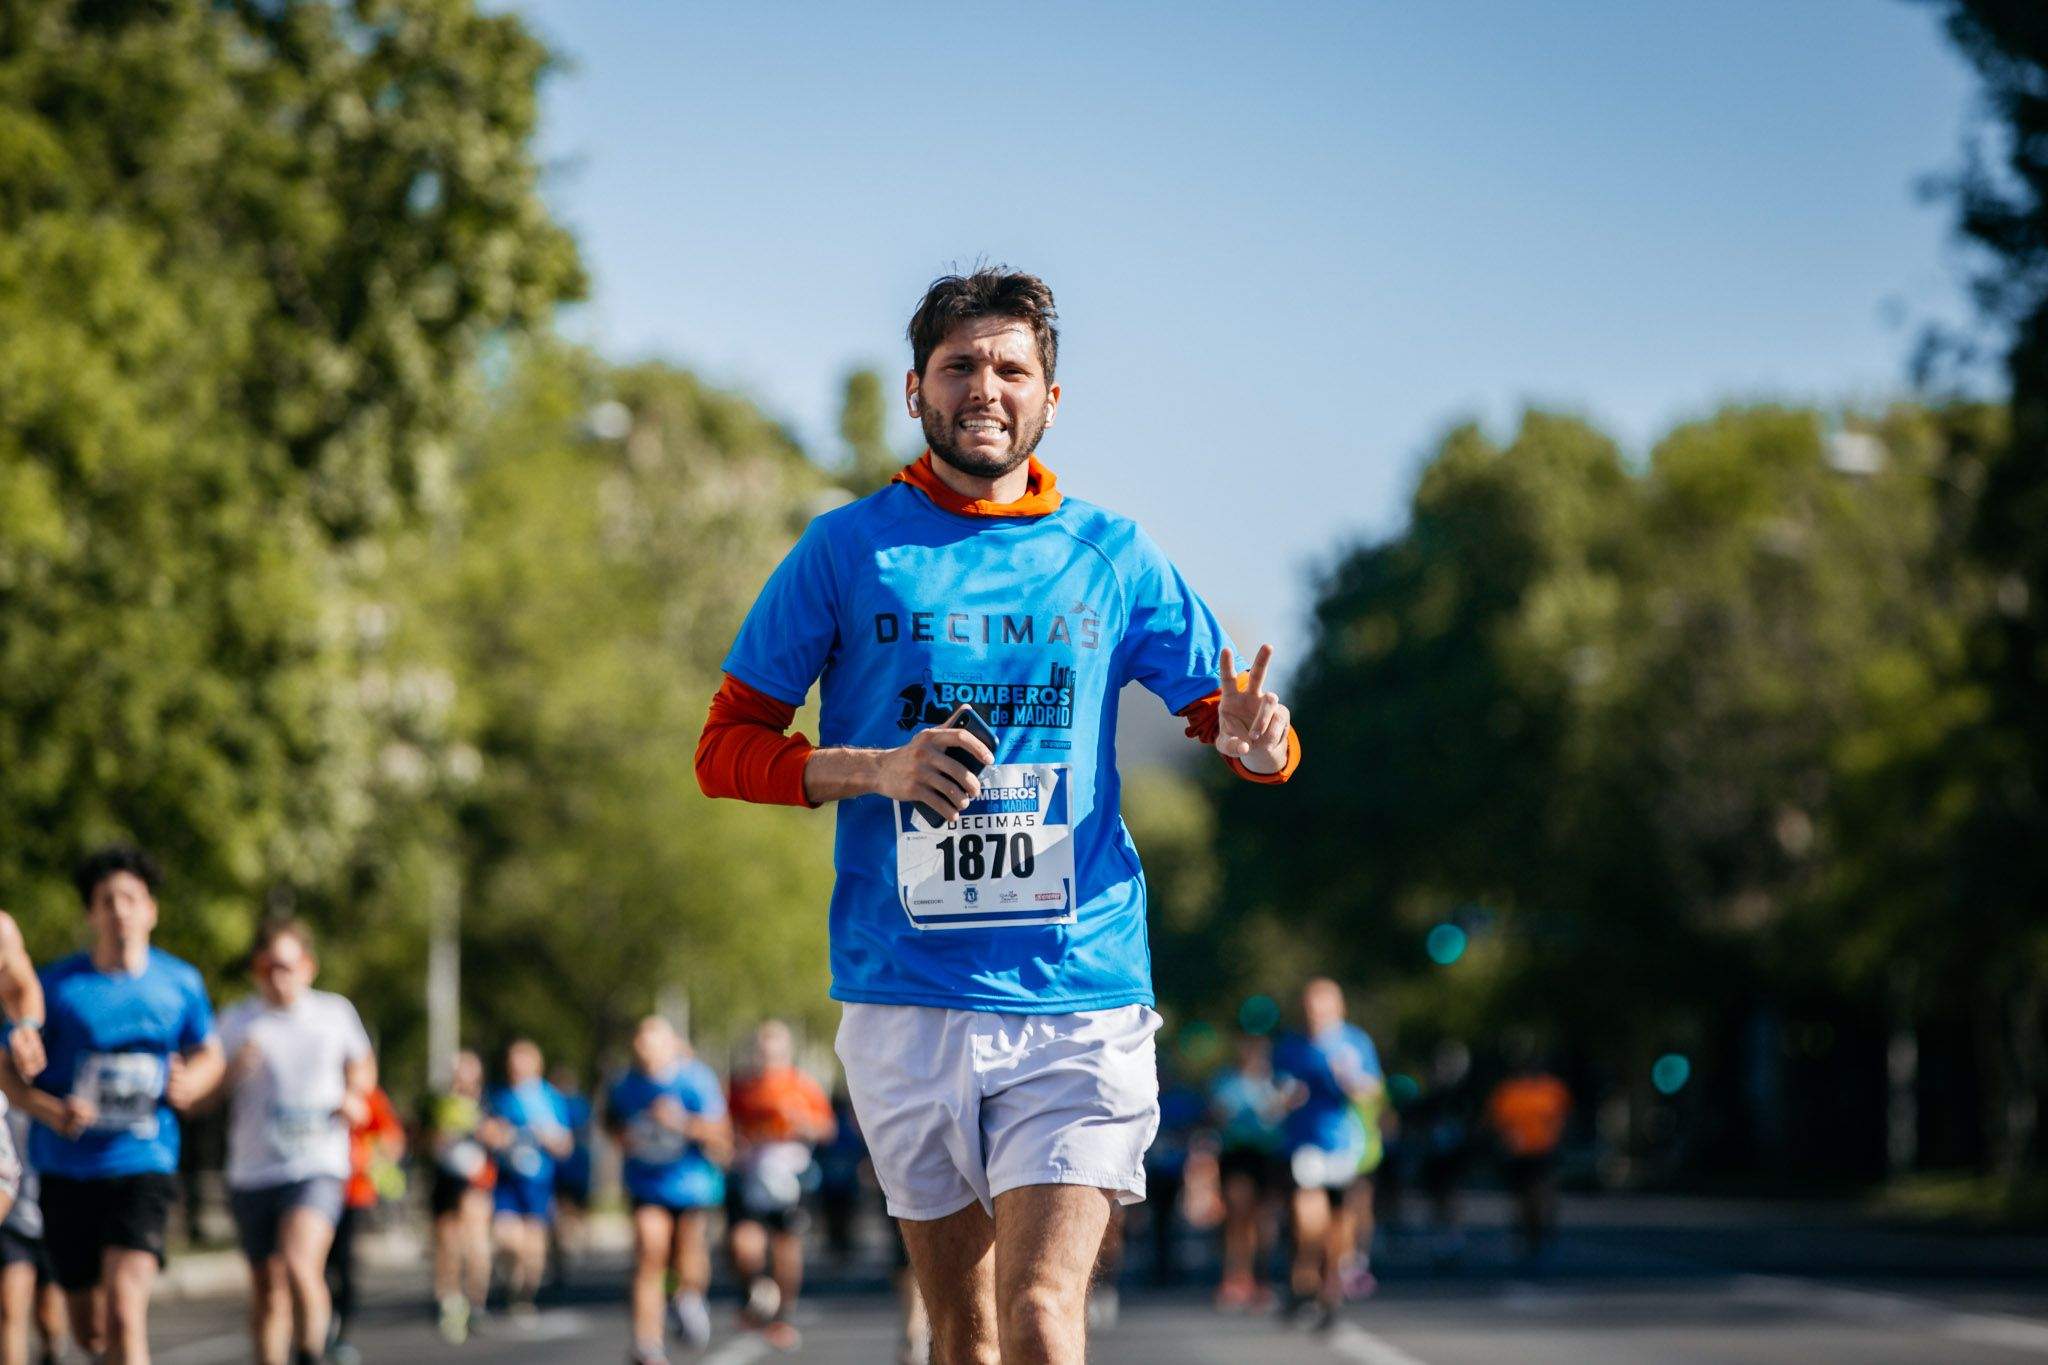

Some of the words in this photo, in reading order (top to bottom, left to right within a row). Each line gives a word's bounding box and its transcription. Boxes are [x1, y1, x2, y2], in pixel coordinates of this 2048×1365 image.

[874, 612, 1100, 649] DECIMAS
[941, 684, 1070, 705] BOMBEROS
[990, 705, 1009, 725] de
[1013, 705, 1070, 727] MADRID
[968, 787, 1037, 801] MBEROS
[1001, 799, 1037, 812] MADRID
[947, 814, 1035, 830] DECIMAS
[935, 832, 1035, 881] 1870
